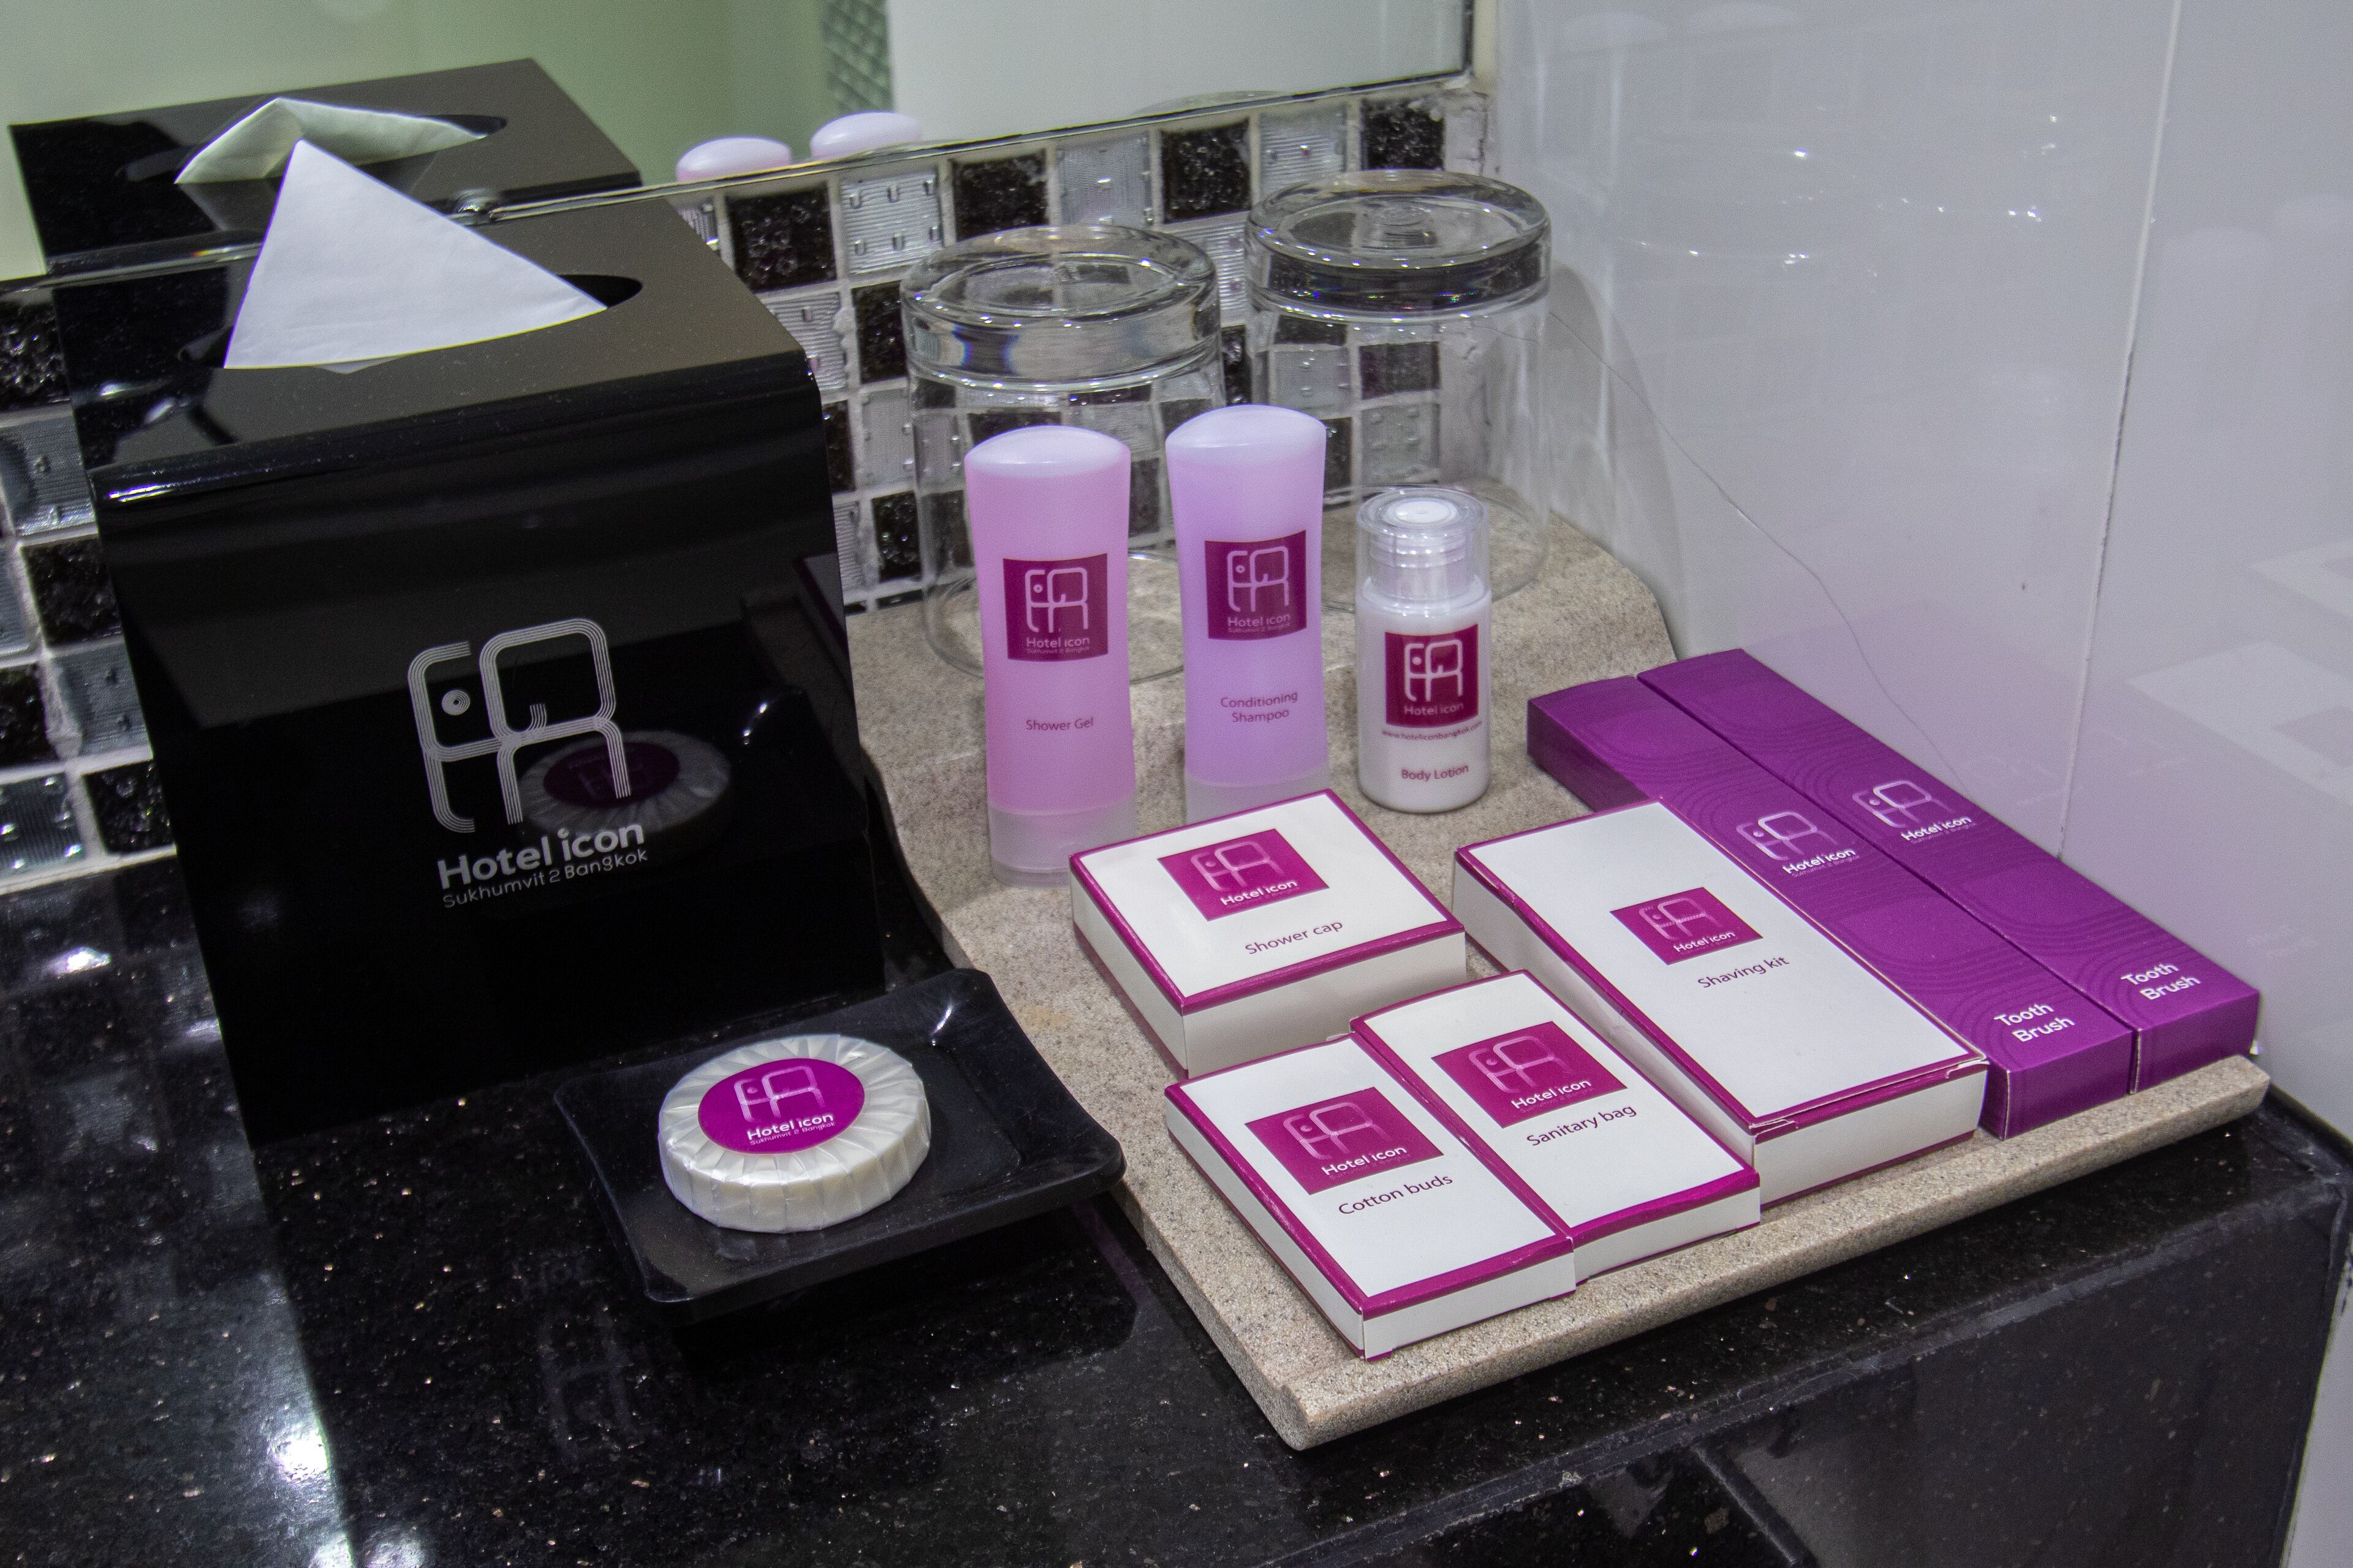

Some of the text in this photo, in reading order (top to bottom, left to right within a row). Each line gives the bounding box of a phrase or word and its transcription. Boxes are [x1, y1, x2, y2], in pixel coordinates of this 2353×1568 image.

[1228, 614, 1290, 627] Hotel icon
[1026, 637, 1090, 648] Hotel icon
[1221, 692, 1298, 708] Conditioning
[1404, 703, 1464, 716] Hotel icon
[1026, 717, 1094, 731] Shower Gel
[1232, 710, 1289, 722] Shampoo
[1401, 765, 1469, 782] Body Lotion
[1901, 823, 1942, 841] Hotel
[1938, 817, 1972, 829] icon
[438, 824, 645, 890] Hotel icon
[1782, 856, 1825, 874] Hotel
[1821, 849, 1857, 862] icon
[443, 849, 648, 908] Sukhumvit 2 Bangkok
[1220, 888, 1264, 906] Hotel
[1263, 881, 1298, 893] icon
[1245, 921, 1343, 955] Shower cap
[1673, 937, 1710, 952] Hotel
[1707, 931, 1736, 942] icon
[1698, 956, 1790, 988] Shaving kit
[2119, 962, 2180, 985] Tooth
[2139, 975, 2202, 1000] Brush
[1993, 1003, 2054, 1026] Tooth
[2012, 1017, 2075, 1042] Brush
[1511, 1088, 1558, 1109] Hotel
[1555, 1080, 1592, 1094] icon
[747, 1114, 834, 1140] Hotel icon
[750, 1131, 792, 1145] Sukhumvit
[801, 1122, 835, 1133] Bangkok
[1526, 1105, 1637, 1146] Sanitary bag
[1321, 1154, 1370, 1176] Hotel
[1368, 1146, 1408, 1161] icon
[1338, 1175, 1453, 1214] Cotton buds
